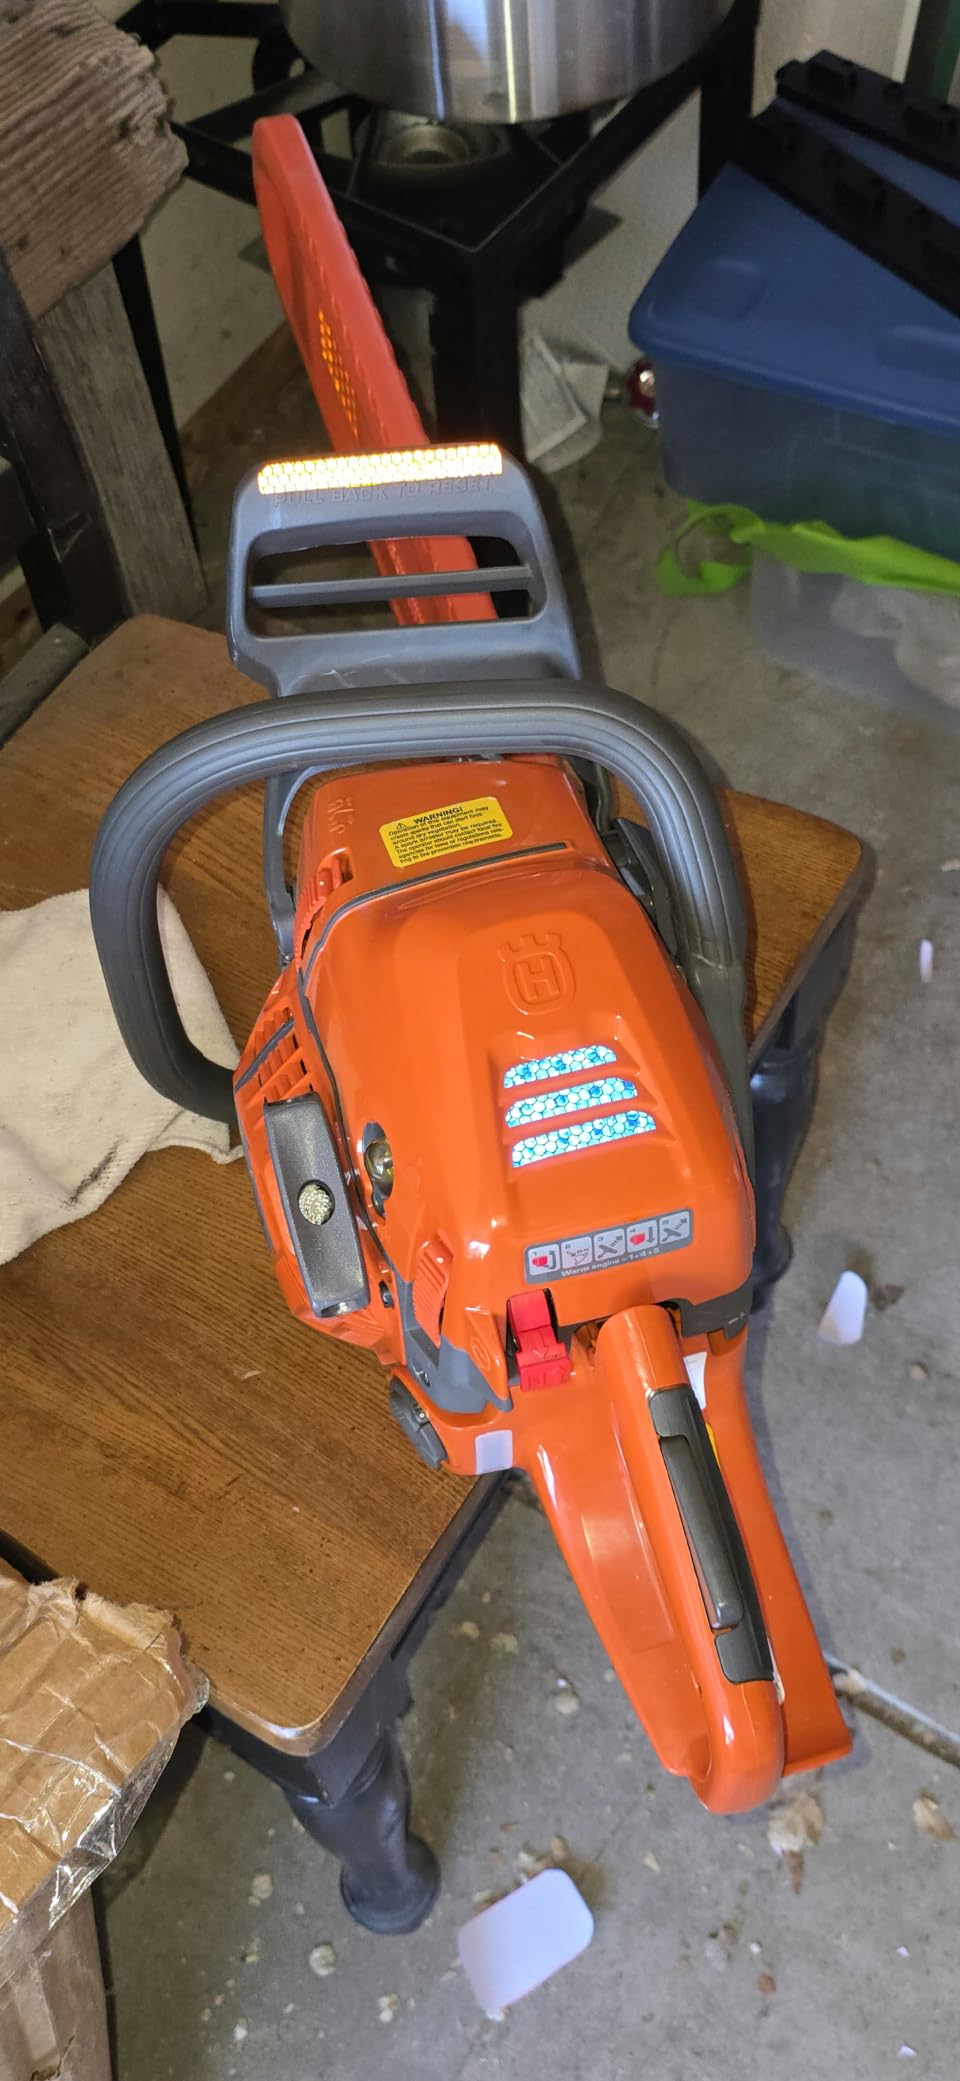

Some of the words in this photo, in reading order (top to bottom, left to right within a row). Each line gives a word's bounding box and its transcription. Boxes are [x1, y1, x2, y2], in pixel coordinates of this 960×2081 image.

[273, 490, 323, 505] PULL
[332, 485, 389, 503] BACK
[398, 481, 422, 496] TO
[430, 476, 494, 494] RESET
[388, 824, 419, 836] Operation
[441, 809, 474, 822] equipment
[413, 807, 463, 824] WARNING!
[392, 836, 415, 845] around
[400, 840, 419, 848] spark
[419, 832, 445, 842] arrestor
[445, 828, 460, 836] may
[408, 841, 433, 851] operator
[433, 835, 453, 843] should
[454, 829, 476, 838] contact
[410, 827, 430, 836] sparks
[561, 1266, 590, 1277] Warm
[592, 1258, 620, 1270] engine
